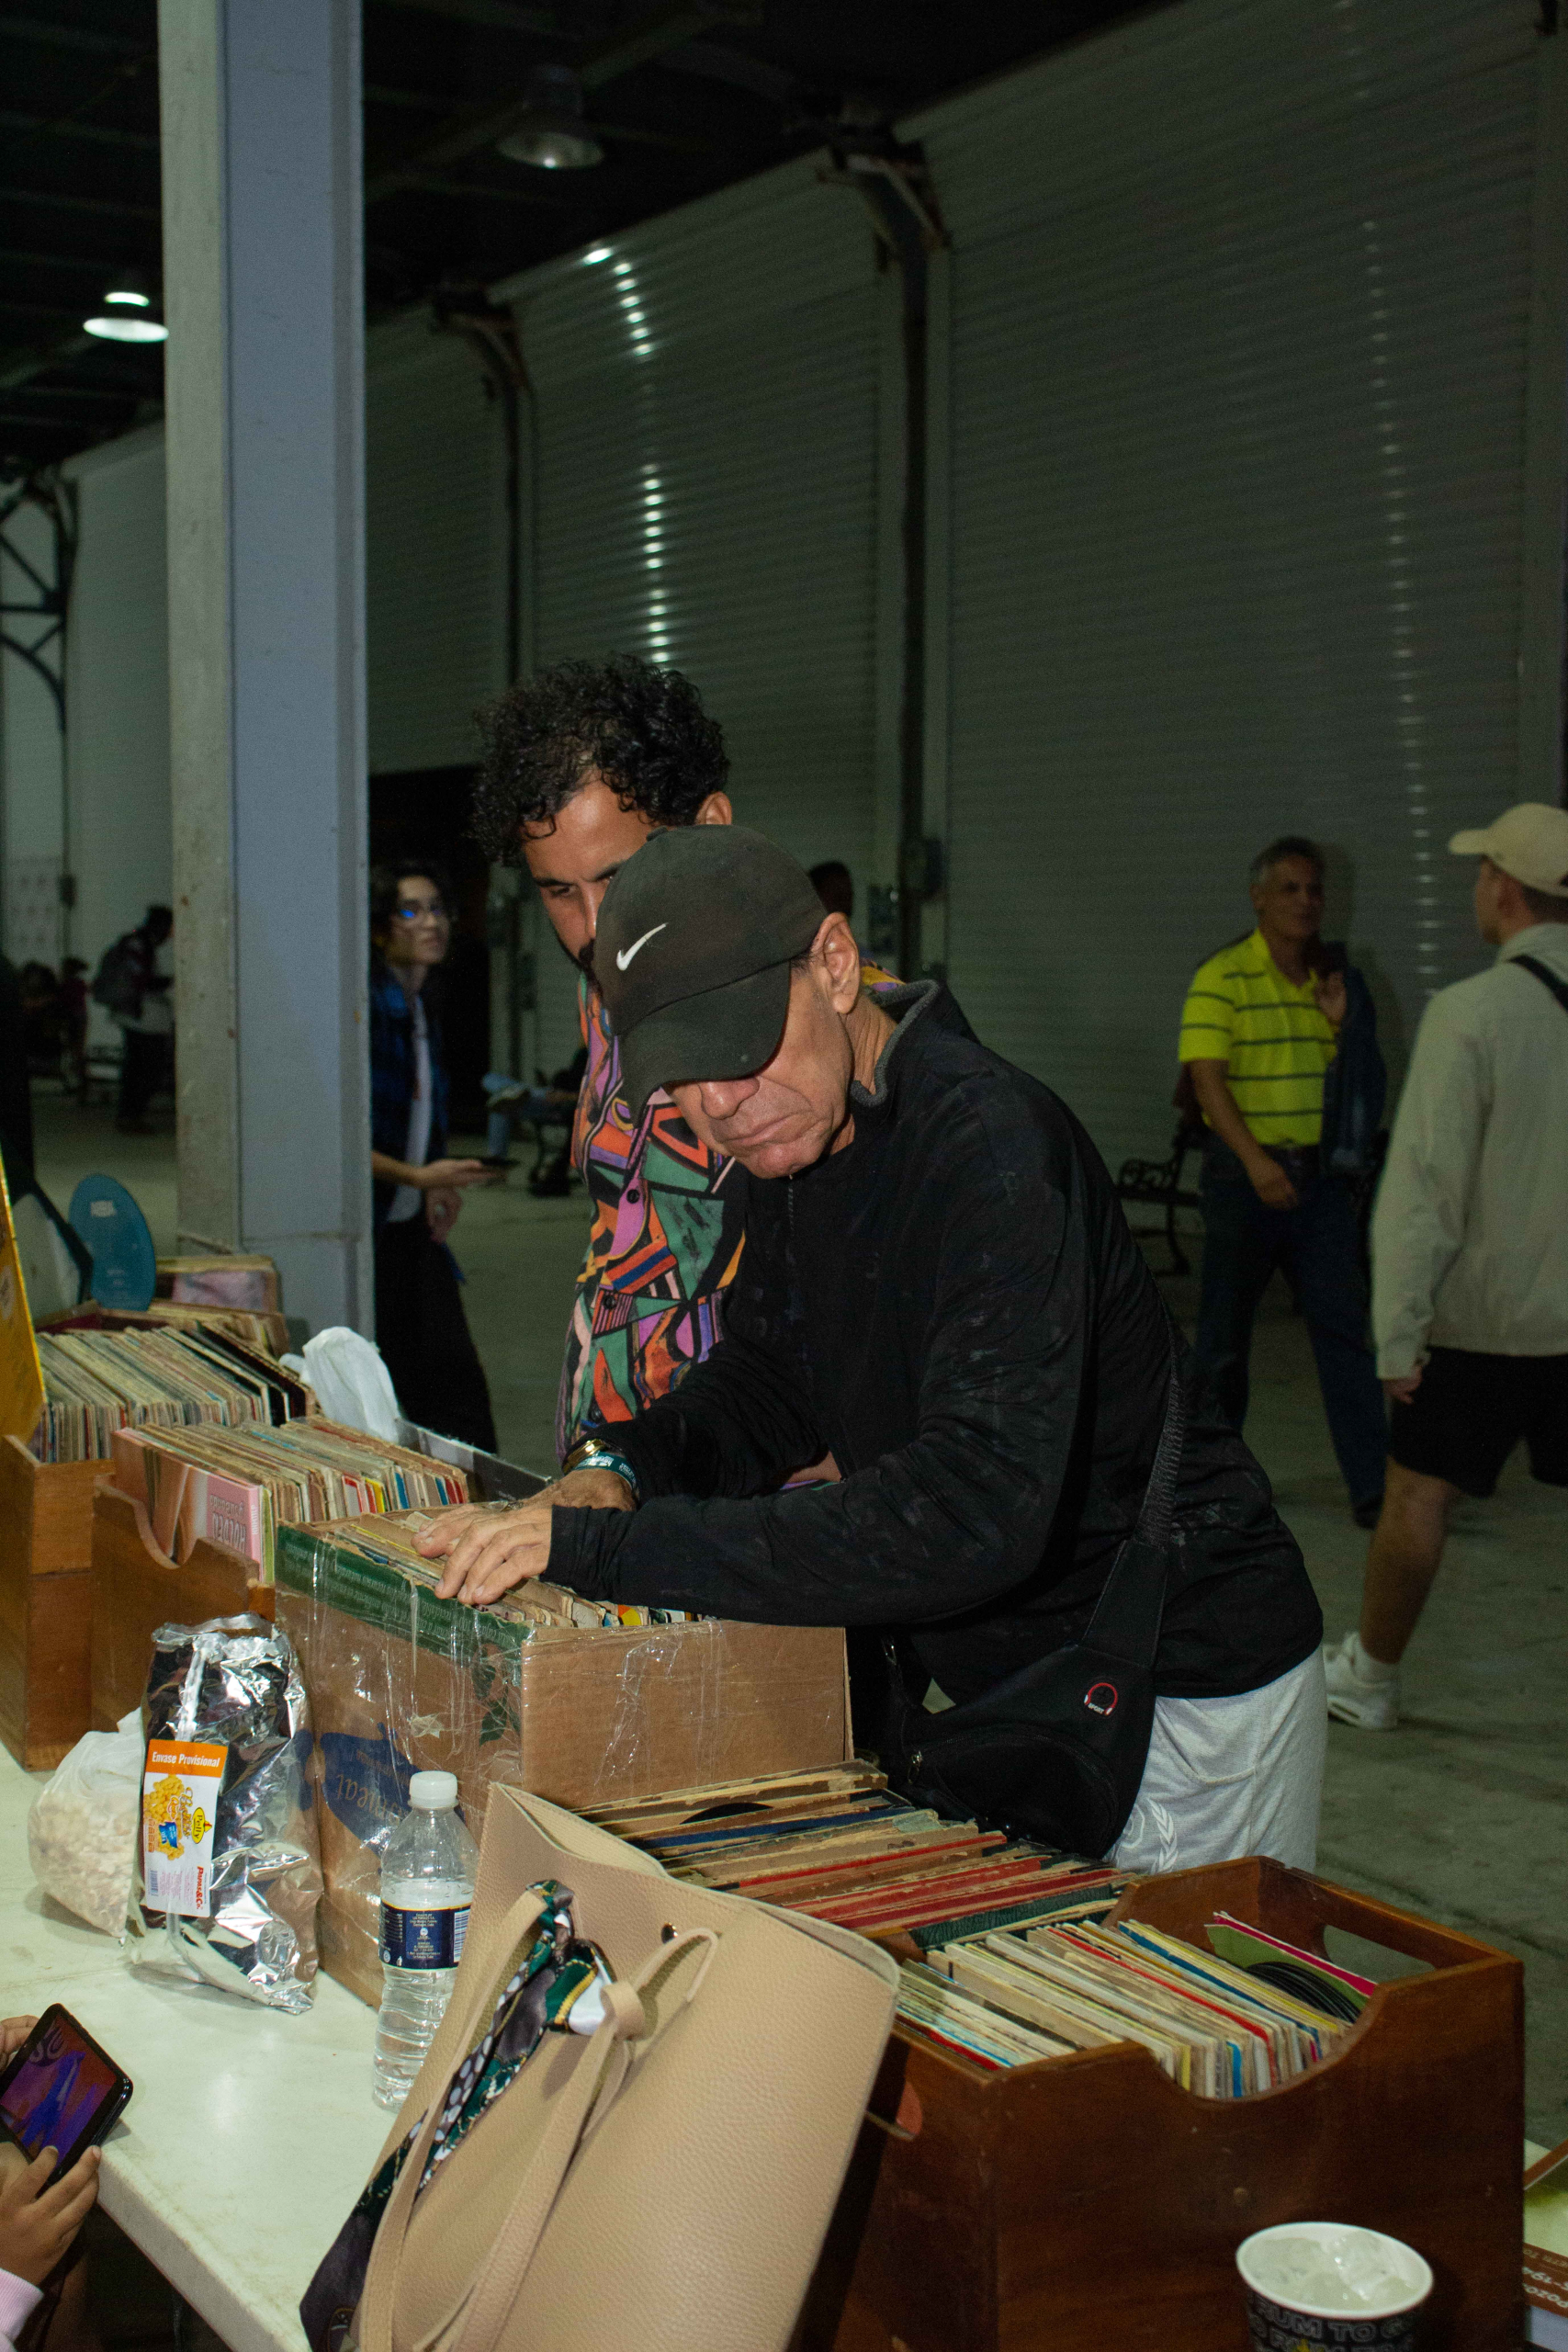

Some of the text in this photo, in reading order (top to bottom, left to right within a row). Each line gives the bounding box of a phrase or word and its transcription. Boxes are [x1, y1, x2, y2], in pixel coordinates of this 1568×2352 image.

[1088, 1702, 1105, 1714] SPORT
[152, 1751, 220, 1767] Envase Provisional
[195, 1815, 203, 1839] Pelly
[1327, 2320, 1377, 2342] TO
